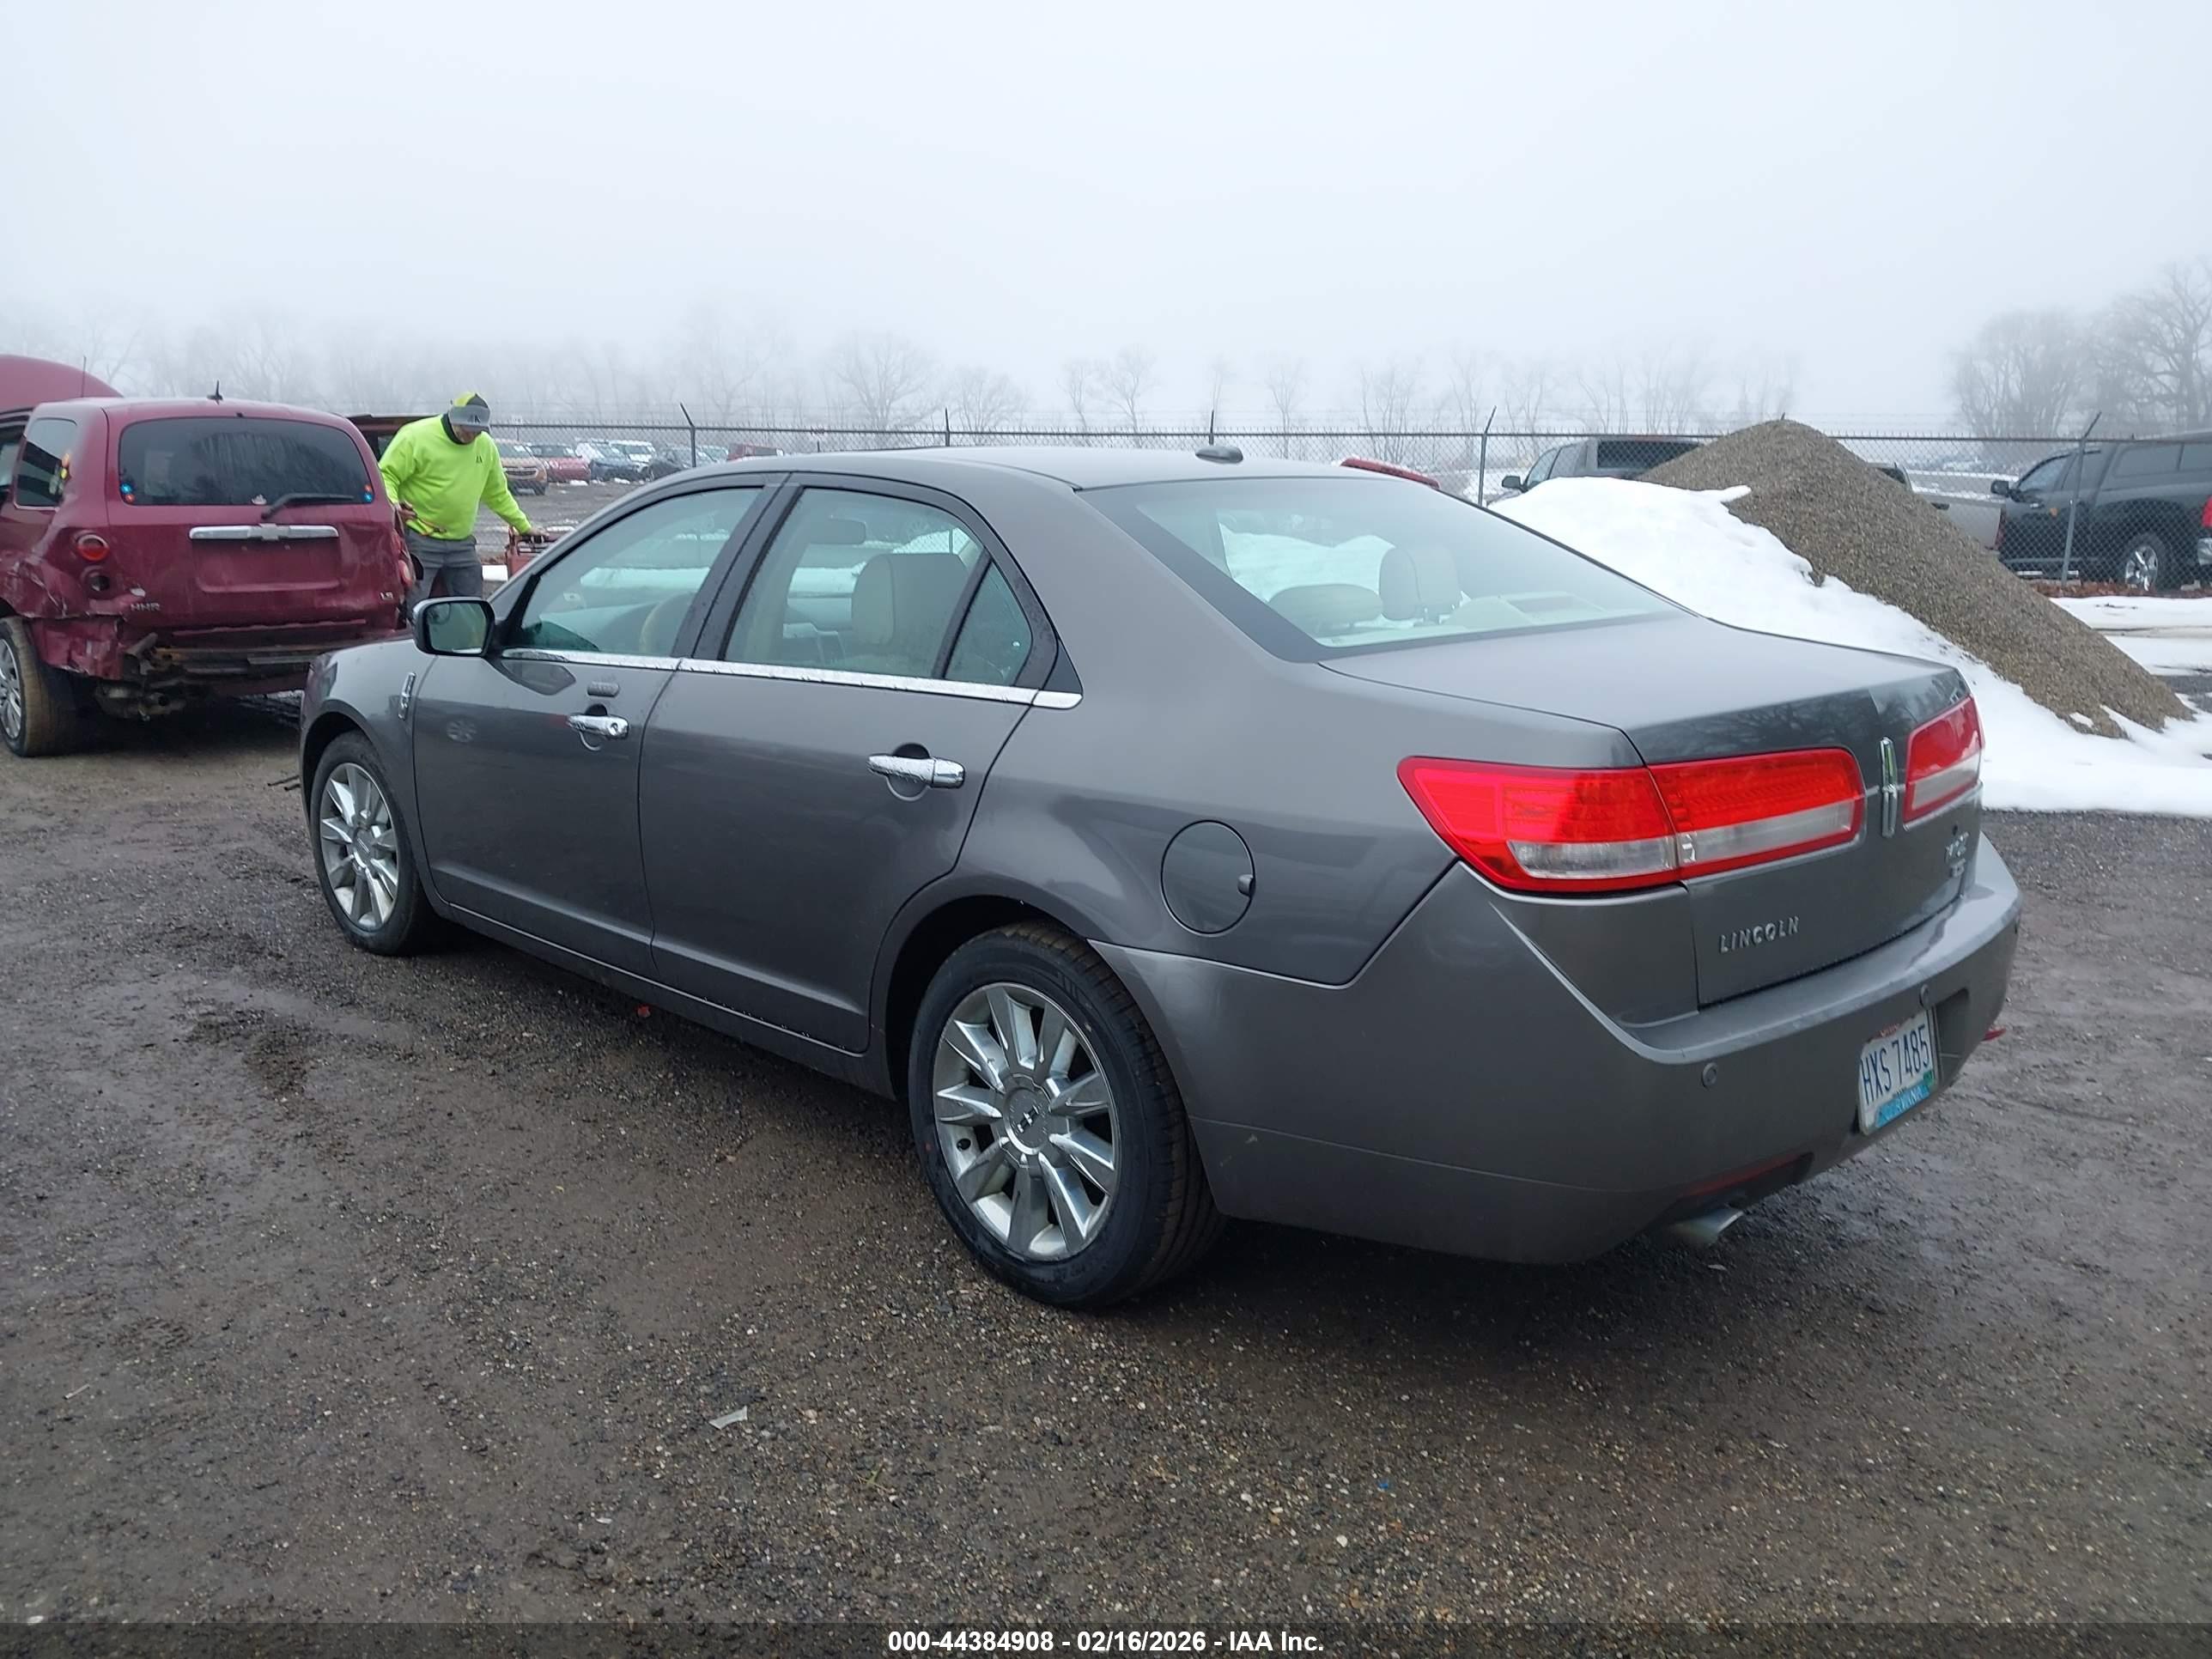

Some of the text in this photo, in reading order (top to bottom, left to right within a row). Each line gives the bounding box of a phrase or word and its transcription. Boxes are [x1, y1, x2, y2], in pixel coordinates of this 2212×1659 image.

[1720, 915, 1800, 953] LINCOLN
[1861, 1048, 1892, 1106] HXS
[1892, 1024, 1929, 1085] 7485
